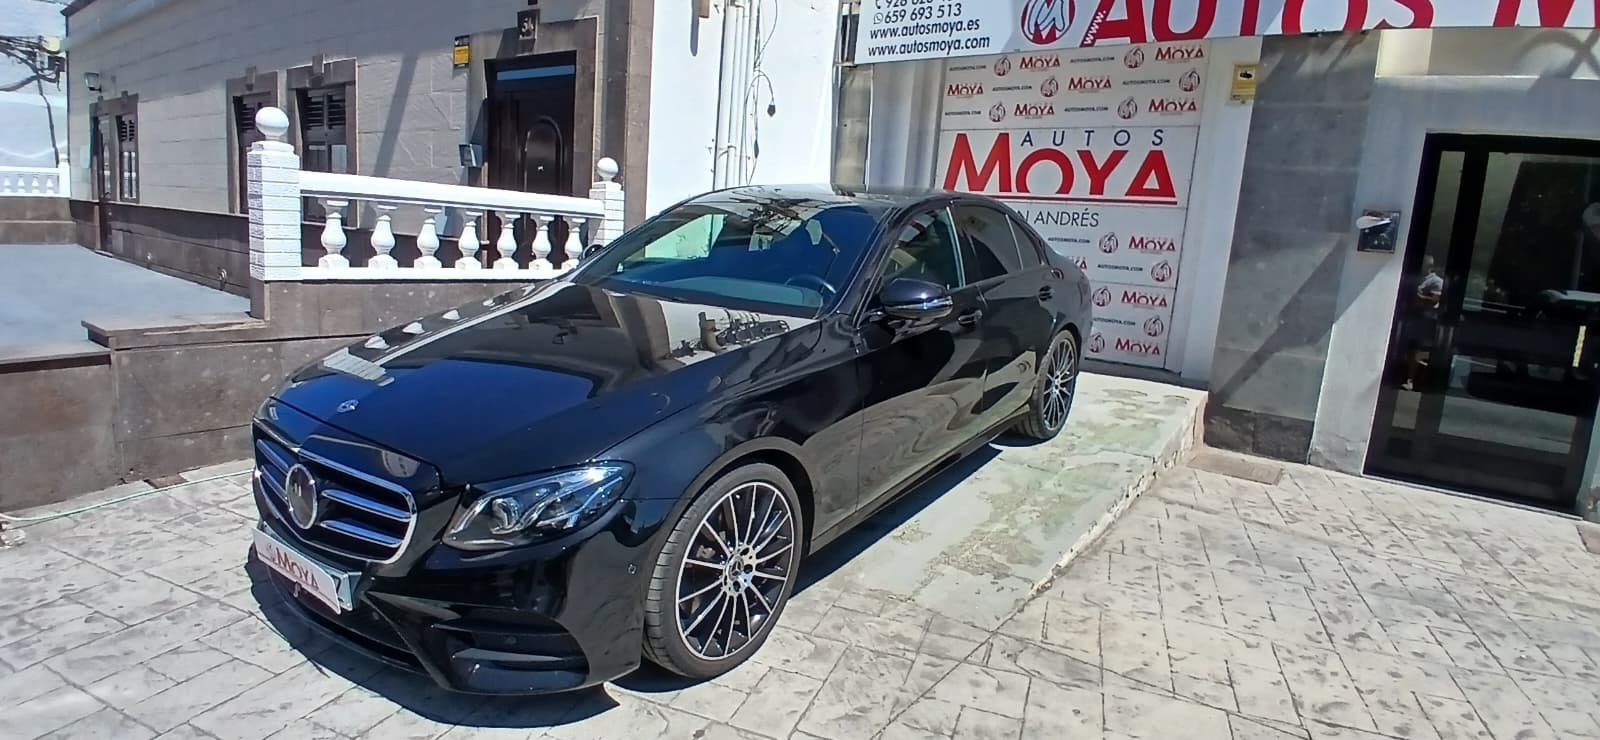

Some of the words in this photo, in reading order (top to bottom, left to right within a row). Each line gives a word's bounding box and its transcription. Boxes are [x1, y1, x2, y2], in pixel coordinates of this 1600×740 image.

[884, 10, 907, 24] 659
[910, 6, 933, 21] 693
[937, 3, 962, 19] 513
[870, 19, 980, 39] www.autosmoya.es
[868, 36, 990, 56] www.autosmoya.com
[1155, 47, 1204, 61] MOYA
[1019, 57, 1061, 70] MOYA
[947, 84, 984, 96] MOYA
[1068, 78, 1112, 90] MOYA
[1014, 104, 1055, 116] MOYA
[1148, 99, 1197, 112] MOYA
[1020, 129, 1165, 147] AUTOS
[943, 132, 1176, 198] MOYA
[1033, 208, 1100, 227] ANDRÉS
[1128, 236, 1176, 251] MOYA
[1121, 290, 1168, 307] MOYA
[1115, 338, 1160, 355] MOYA
